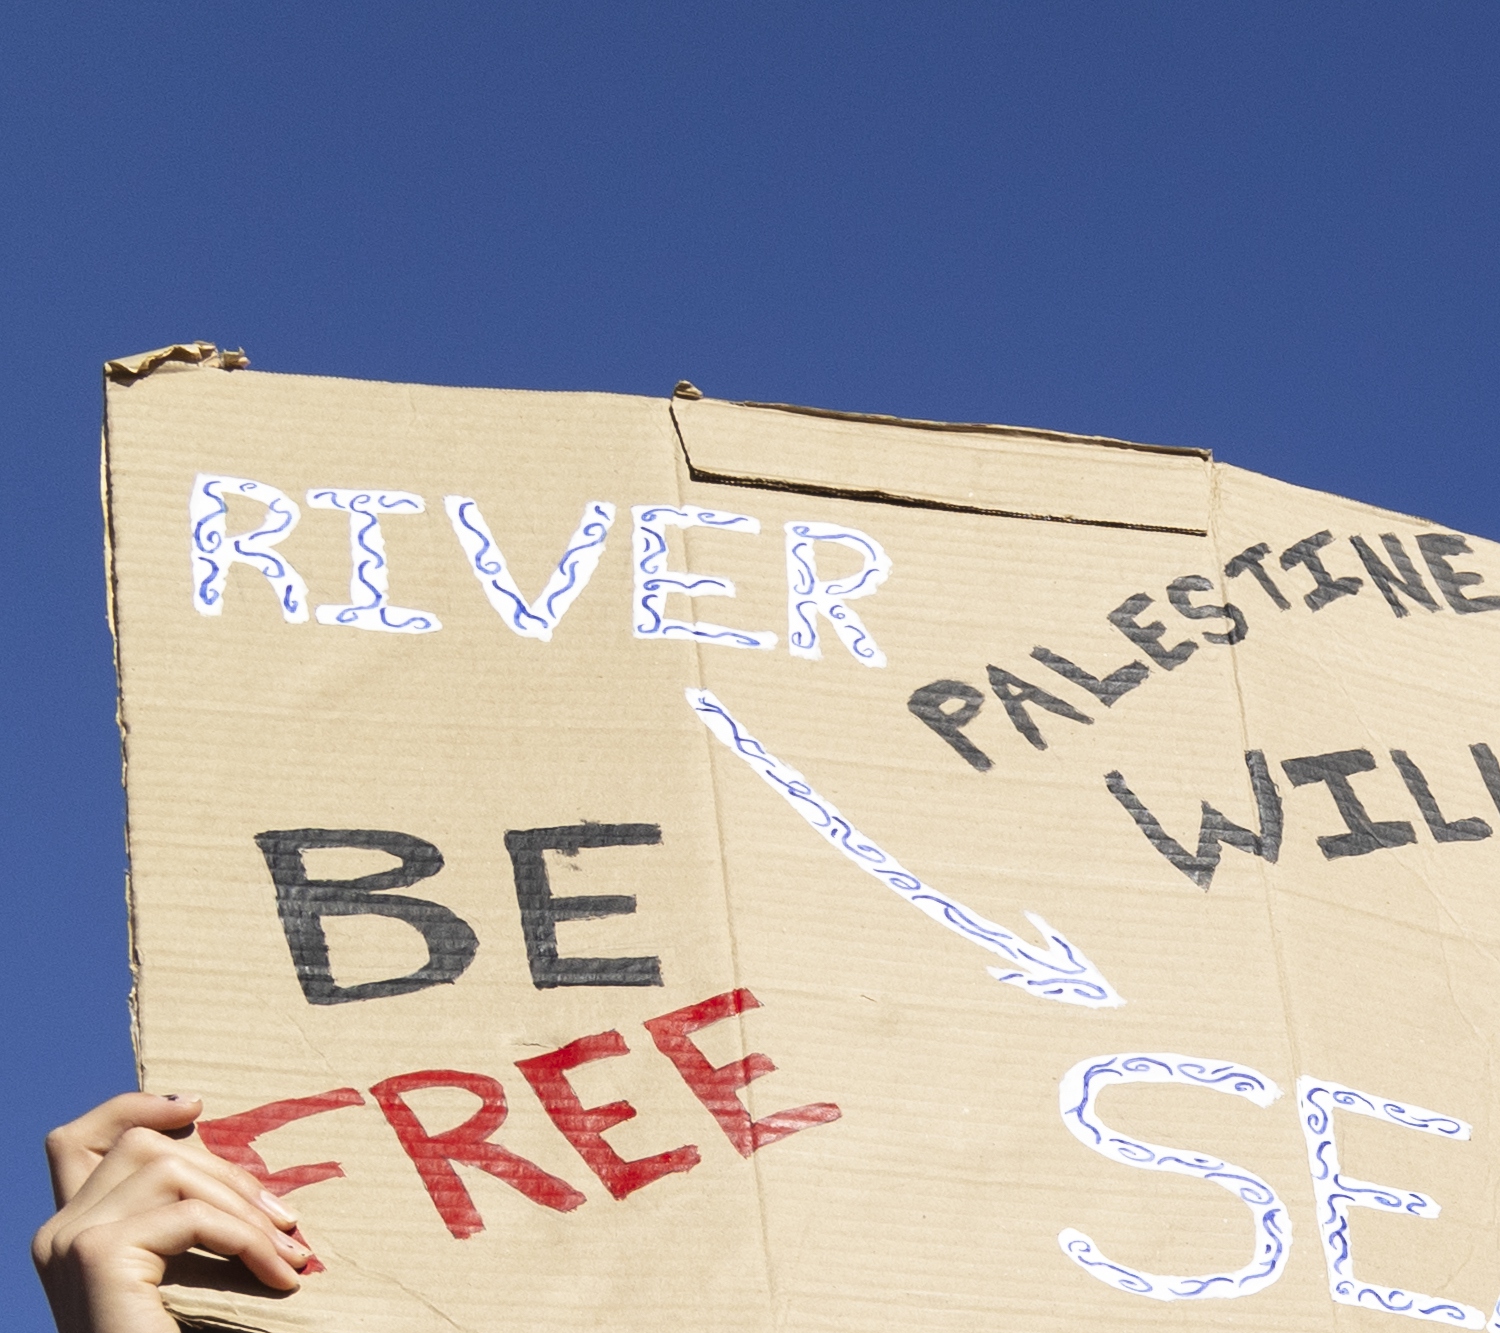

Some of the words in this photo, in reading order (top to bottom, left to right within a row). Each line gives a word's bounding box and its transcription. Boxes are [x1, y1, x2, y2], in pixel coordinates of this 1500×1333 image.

[190, 474, 895, 668] RIVER
[255, 819, 665, 1005] BE
[196, 988, 843, 1275] FREE
